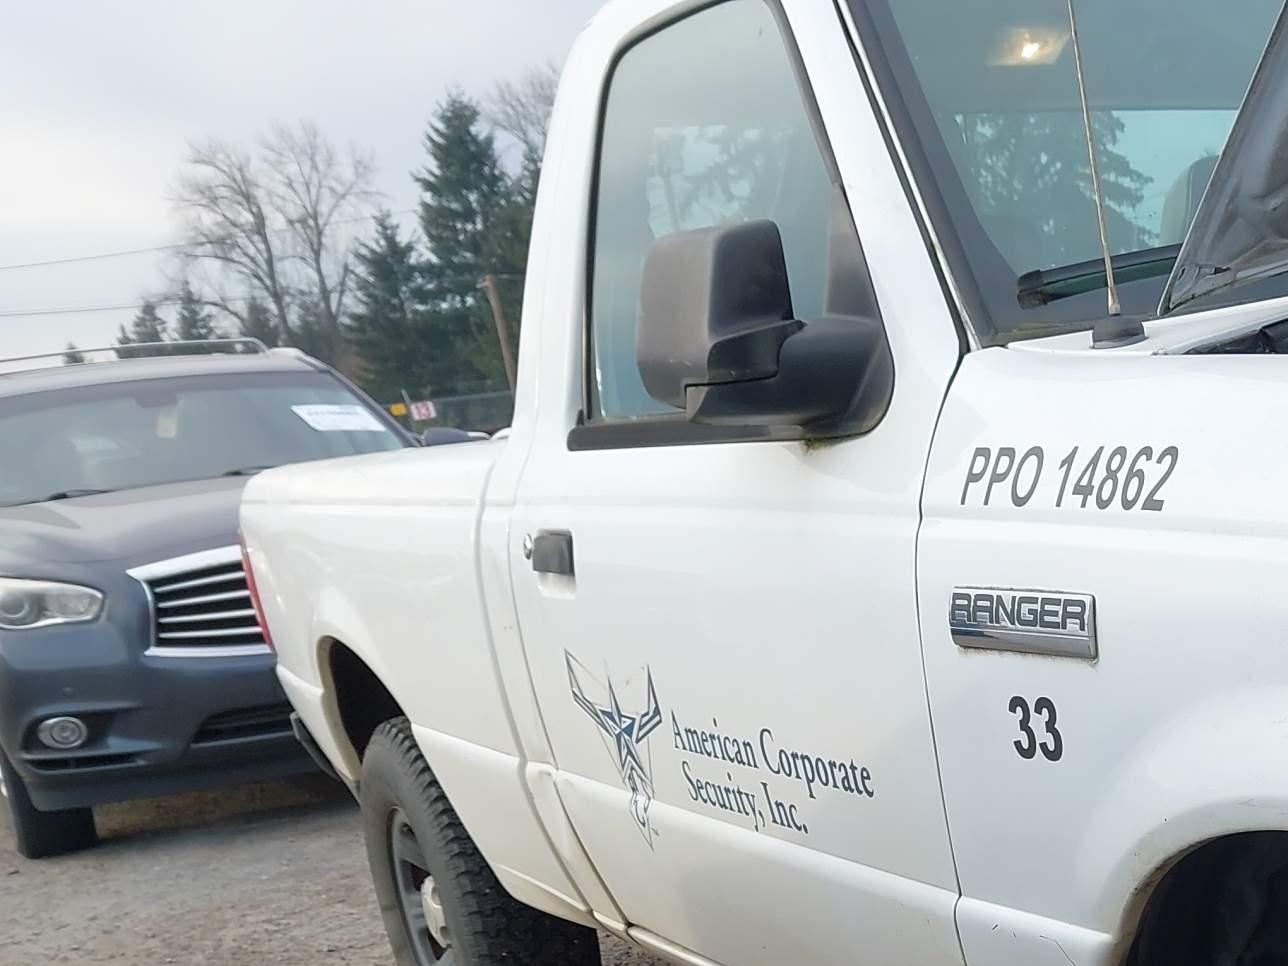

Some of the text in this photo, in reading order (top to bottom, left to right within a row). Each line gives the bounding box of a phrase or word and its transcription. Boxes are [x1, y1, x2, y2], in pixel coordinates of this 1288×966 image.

[960, 445, 1179, 512] PPO 14862
[950, 592, 1087, 632] RANGER
[671, 709, 875, 800] American Corporate
[1008, 695, 1064, 762] 33
[681, 760, 809, 835] Security, Inc.
